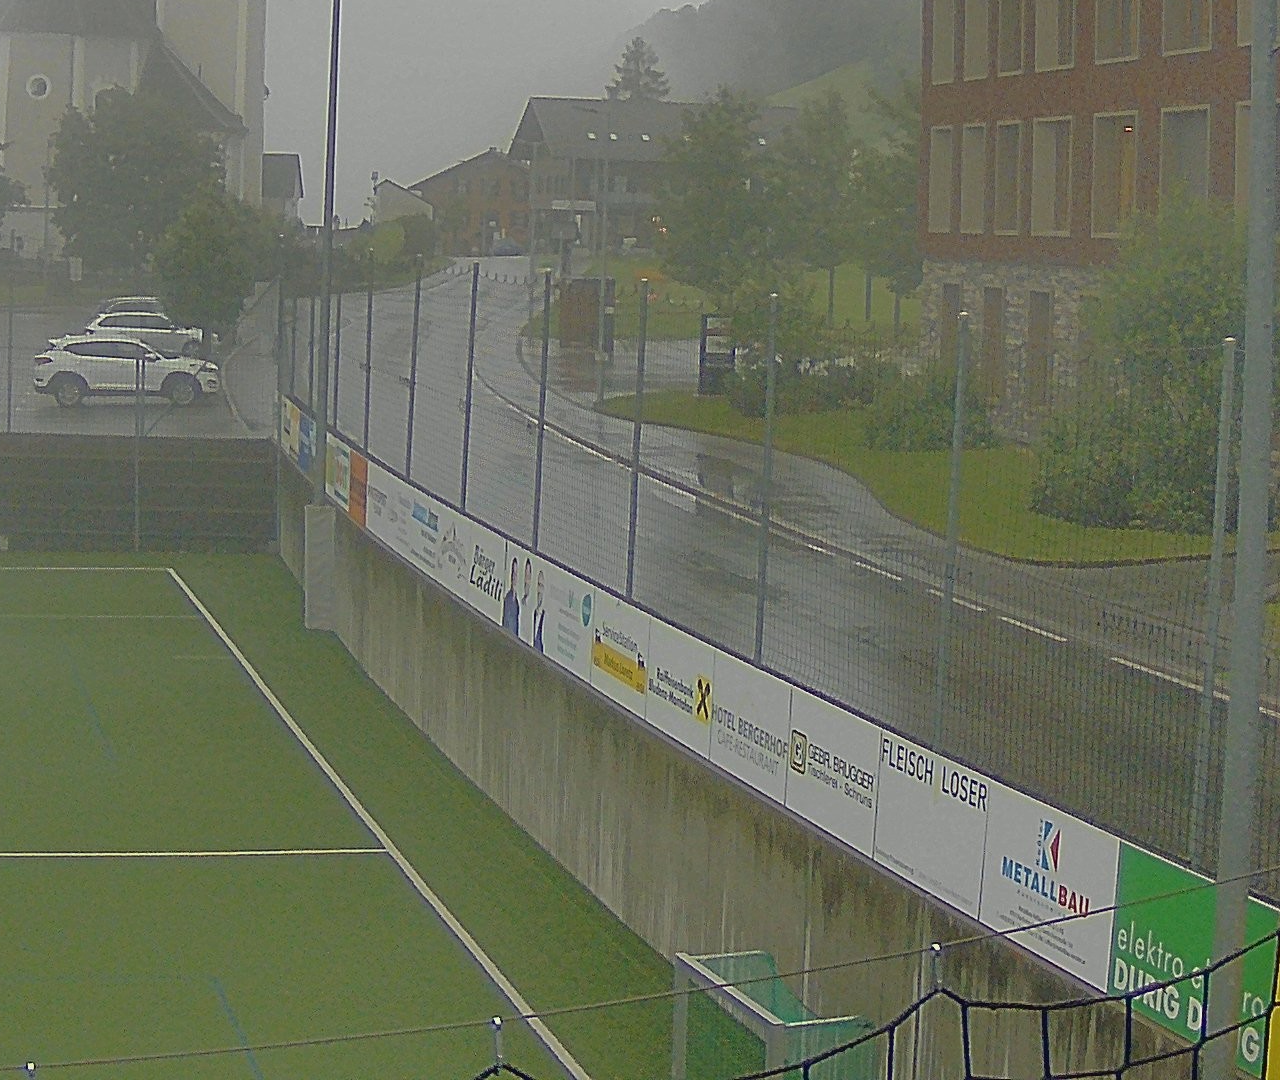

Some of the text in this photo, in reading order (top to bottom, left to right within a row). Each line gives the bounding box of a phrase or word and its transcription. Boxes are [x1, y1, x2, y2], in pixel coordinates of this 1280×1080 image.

[470, 564, 503, 602] Lädili
[712, 703, 788, 759] HOTEL BERGERHOF
[808, 743, 874, 793] GEBR. BRUGGER
[844, 782, 873, 809] Schruns
[882, 738, 987, 813] FLEISCH LOSER
[1002, 856, 1090, 917] METALLBAU
[1117, 920, 1184, 979] elektro
